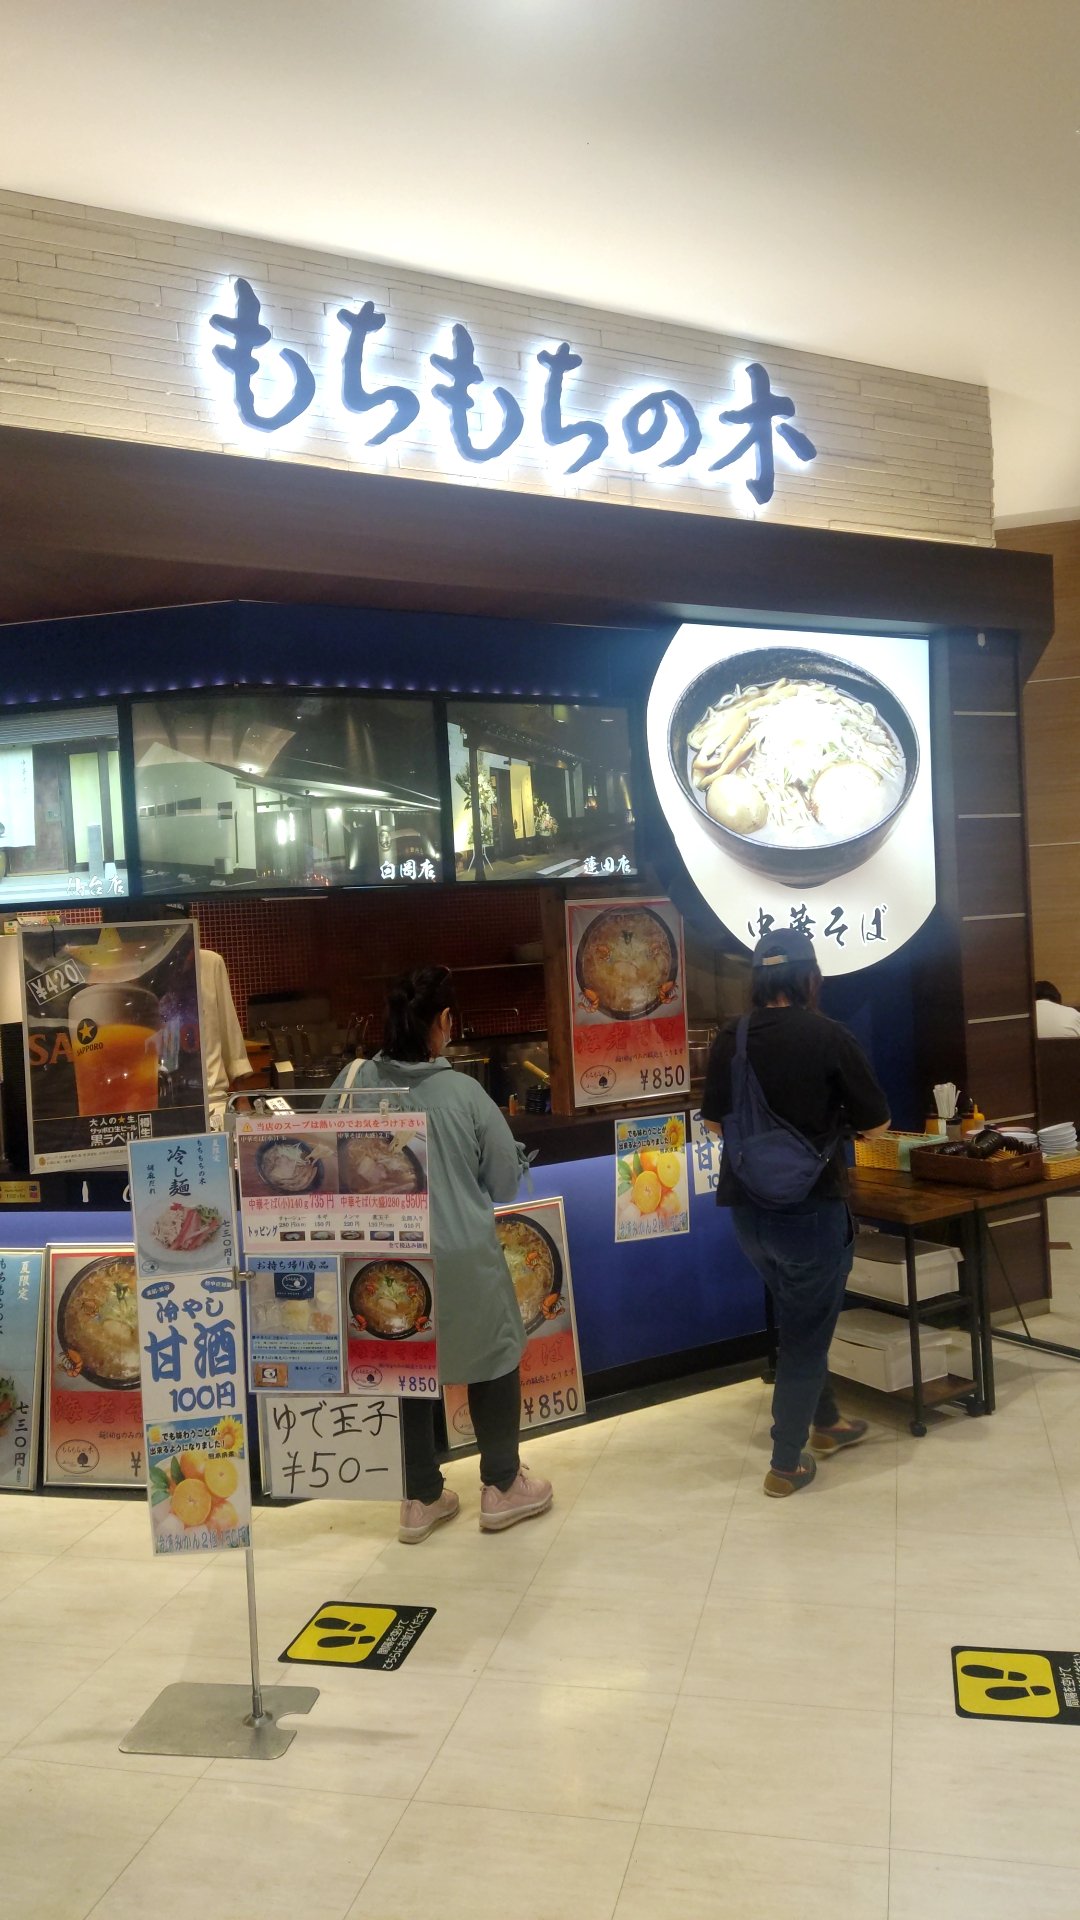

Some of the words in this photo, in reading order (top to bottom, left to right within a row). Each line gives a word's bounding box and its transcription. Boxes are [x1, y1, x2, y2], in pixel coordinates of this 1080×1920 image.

[209, 278, 817, 505] もちもちの木
[379, 859, 436, 880] 白岡店
[583, 855, 632, 875] 蓮田店
[748, 904, 887, 946] 中華そば
[77, 1042, 103, 1057] SAPPORO
[640, 1065, 684, 1091] ¥850
[90, 1125, 137, 1134] サッポロ生ビール
[91, 1132, 137, 1147] 黒ラベル
[167, 1145, 192, 1197] 冷し麺
[248, 1226, 278, 1237] トッピング
[18, 1260, 31, 1301] 夏限定
[156, 1296, 224, 1323] 冷やし
[144, 1319, 236, 1382] 甘酒
[169, 1381, 235, 1412] 100円
[398, 1375, 437, 1392] ¥850
[524, 1387, 578, 1423] ¥850
[273, 1400, 398, 1444] ゆで玉子
